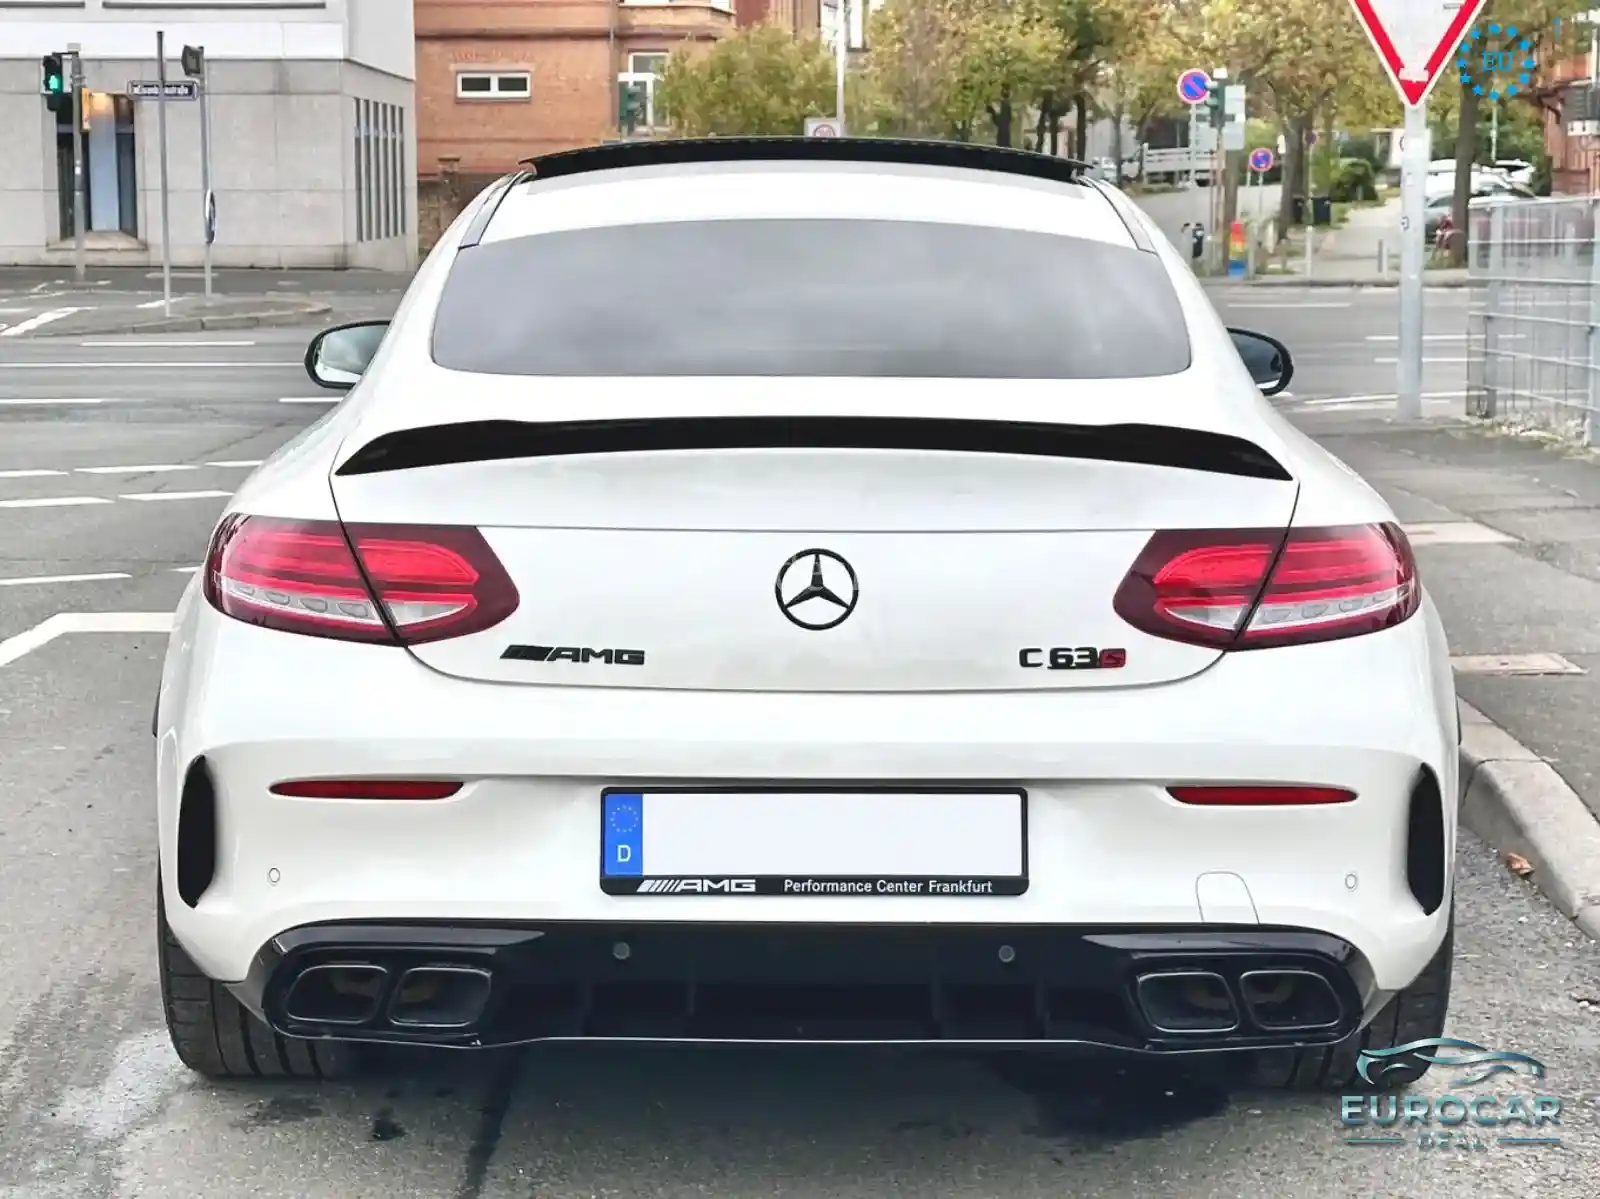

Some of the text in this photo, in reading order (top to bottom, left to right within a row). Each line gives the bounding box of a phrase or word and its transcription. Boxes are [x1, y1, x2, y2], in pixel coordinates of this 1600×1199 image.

[1019, 647, 1043, 668] C
[616, 844, 632, 863] D
[784, 879, 872, 893] Performance
[876, 880, 923, 893] Center
[929, 880, 993, 893] Frankfurt
